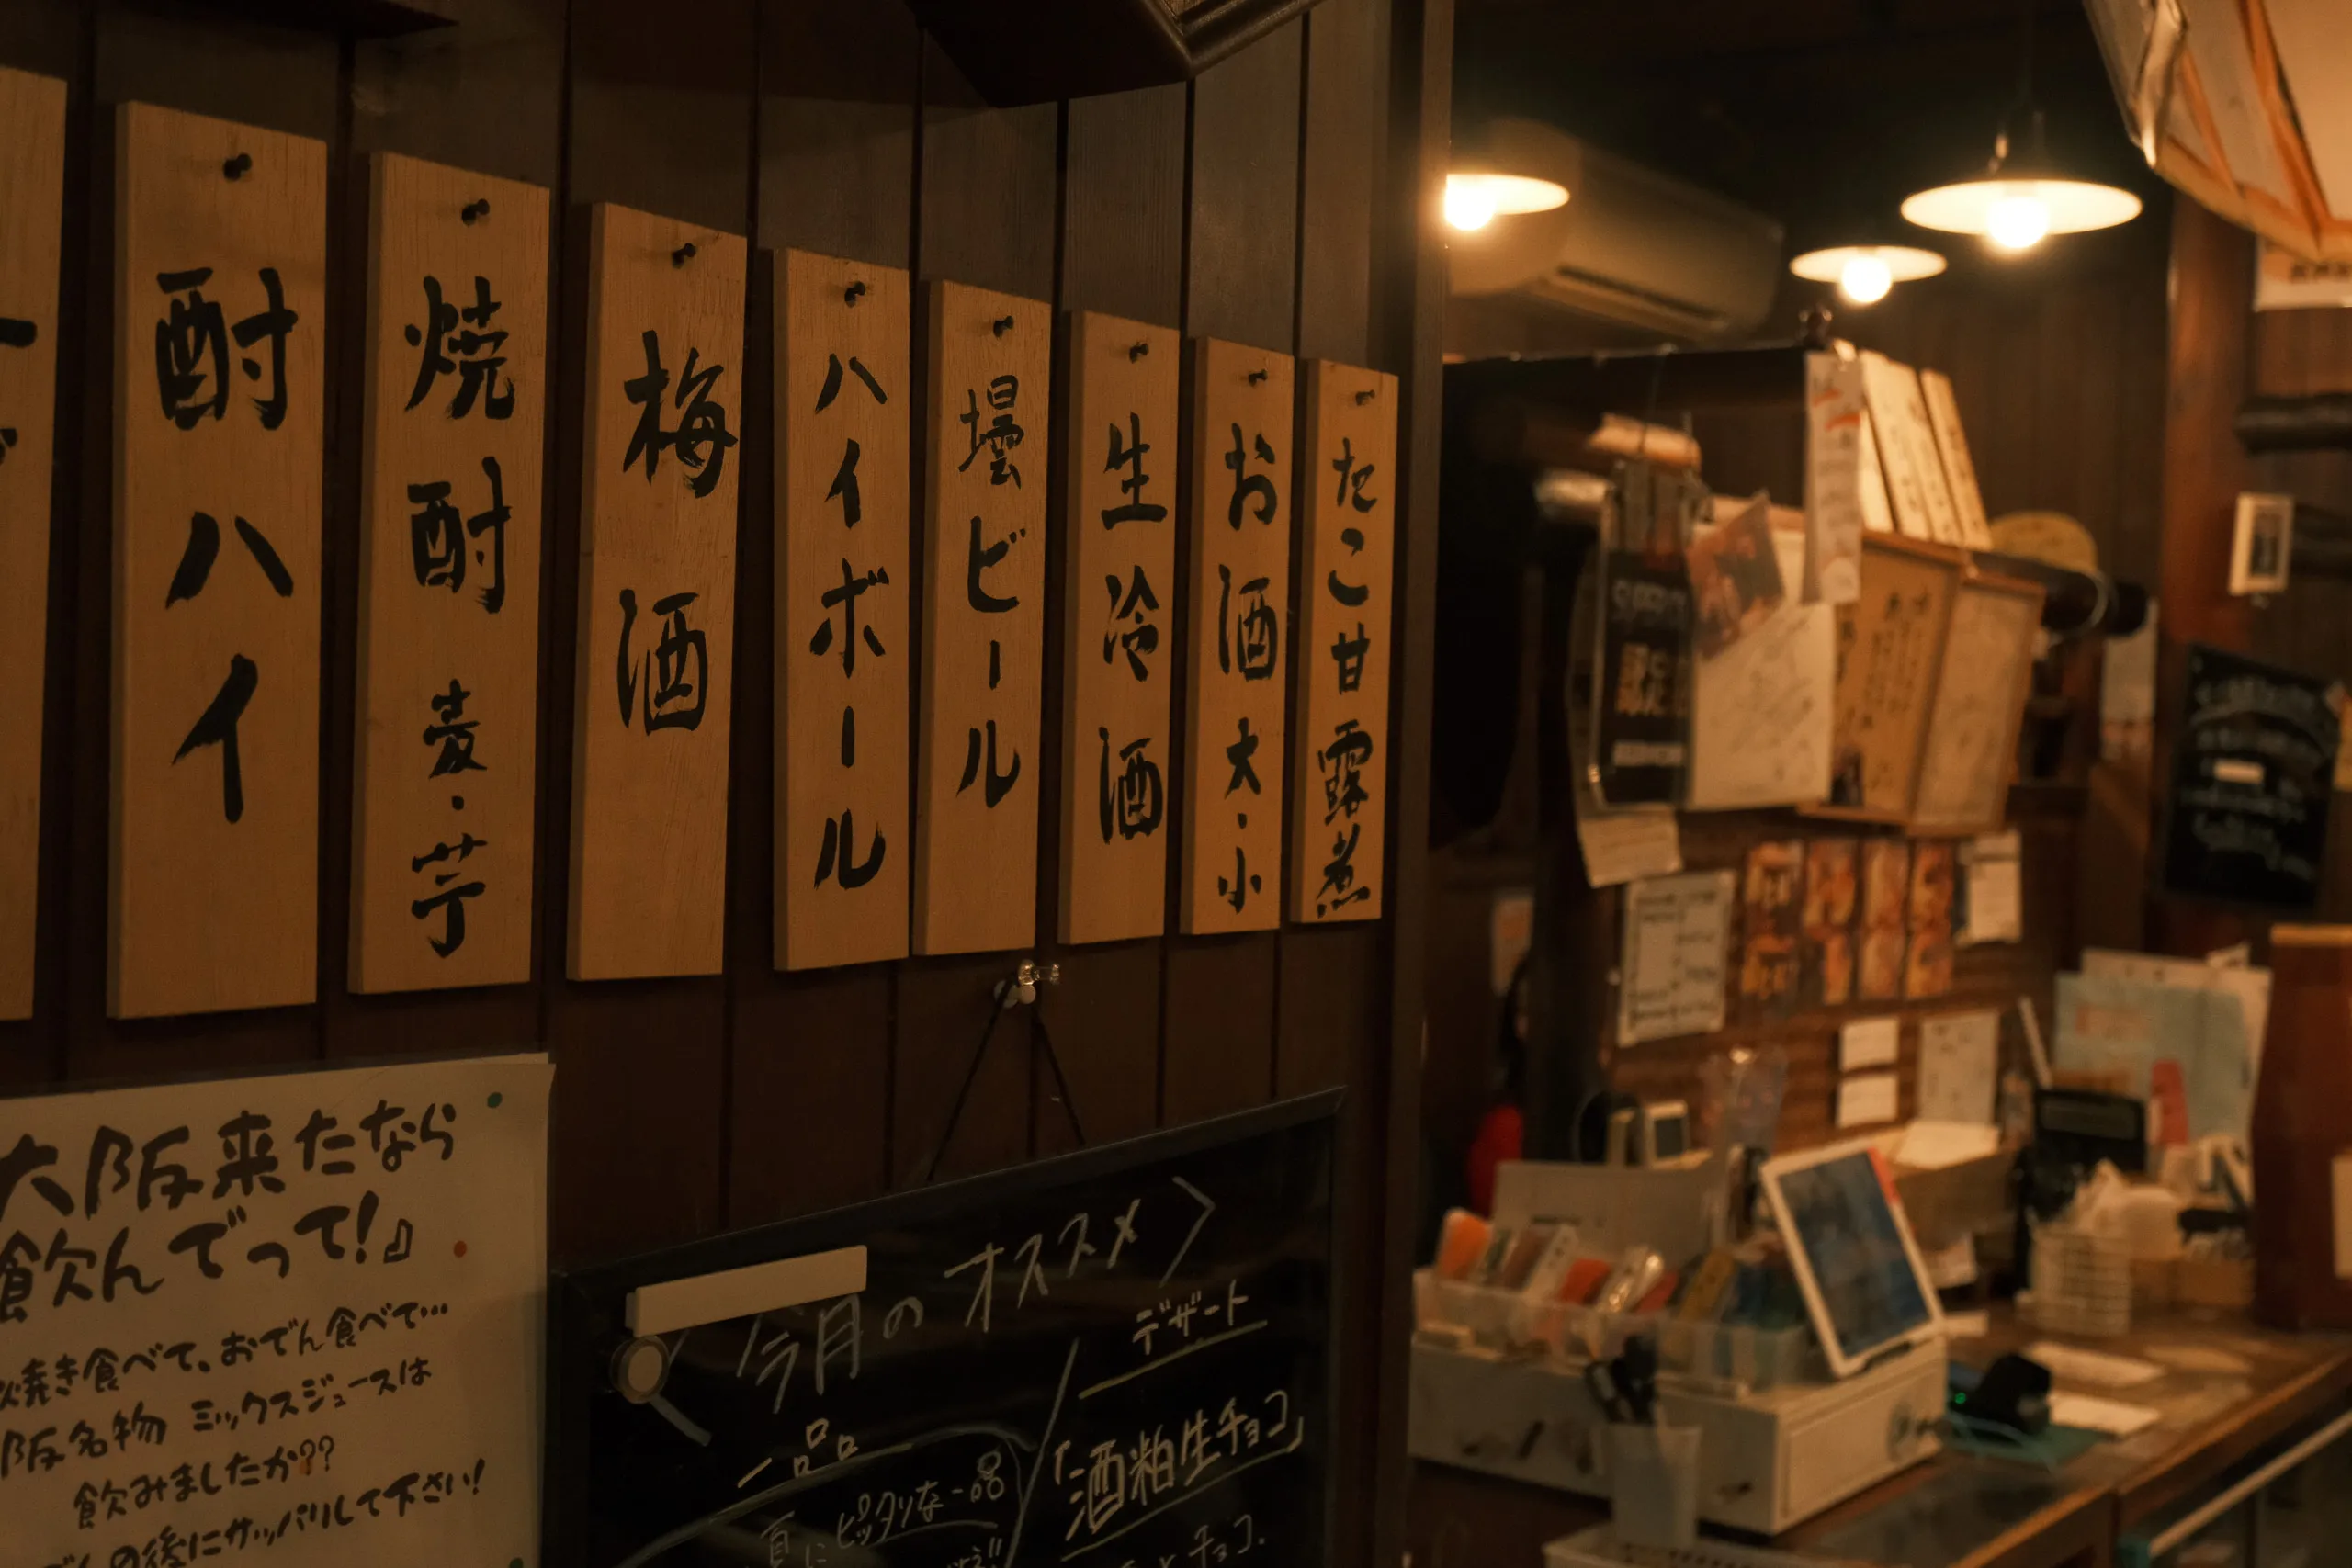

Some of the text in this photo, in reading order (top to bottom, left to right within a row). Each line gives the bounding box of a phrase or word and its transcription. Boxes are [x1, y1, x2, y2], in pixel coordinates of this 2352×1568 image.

[156, 267, 299, 824] 酎ハイ
[617, 331, 739, 735] 梅酒
[810, 354, 889, 890] ハイボール
[956, 375, 1026, 808] 壜ビール
[1100, 412, 1168, 845] 生冷酒
[1315, 438, 1378, 918] たこ甘露煮
[0, 1100, 457, 1222] 大阪来たなら
[1132, 1279, 1250, 1356] デザート
